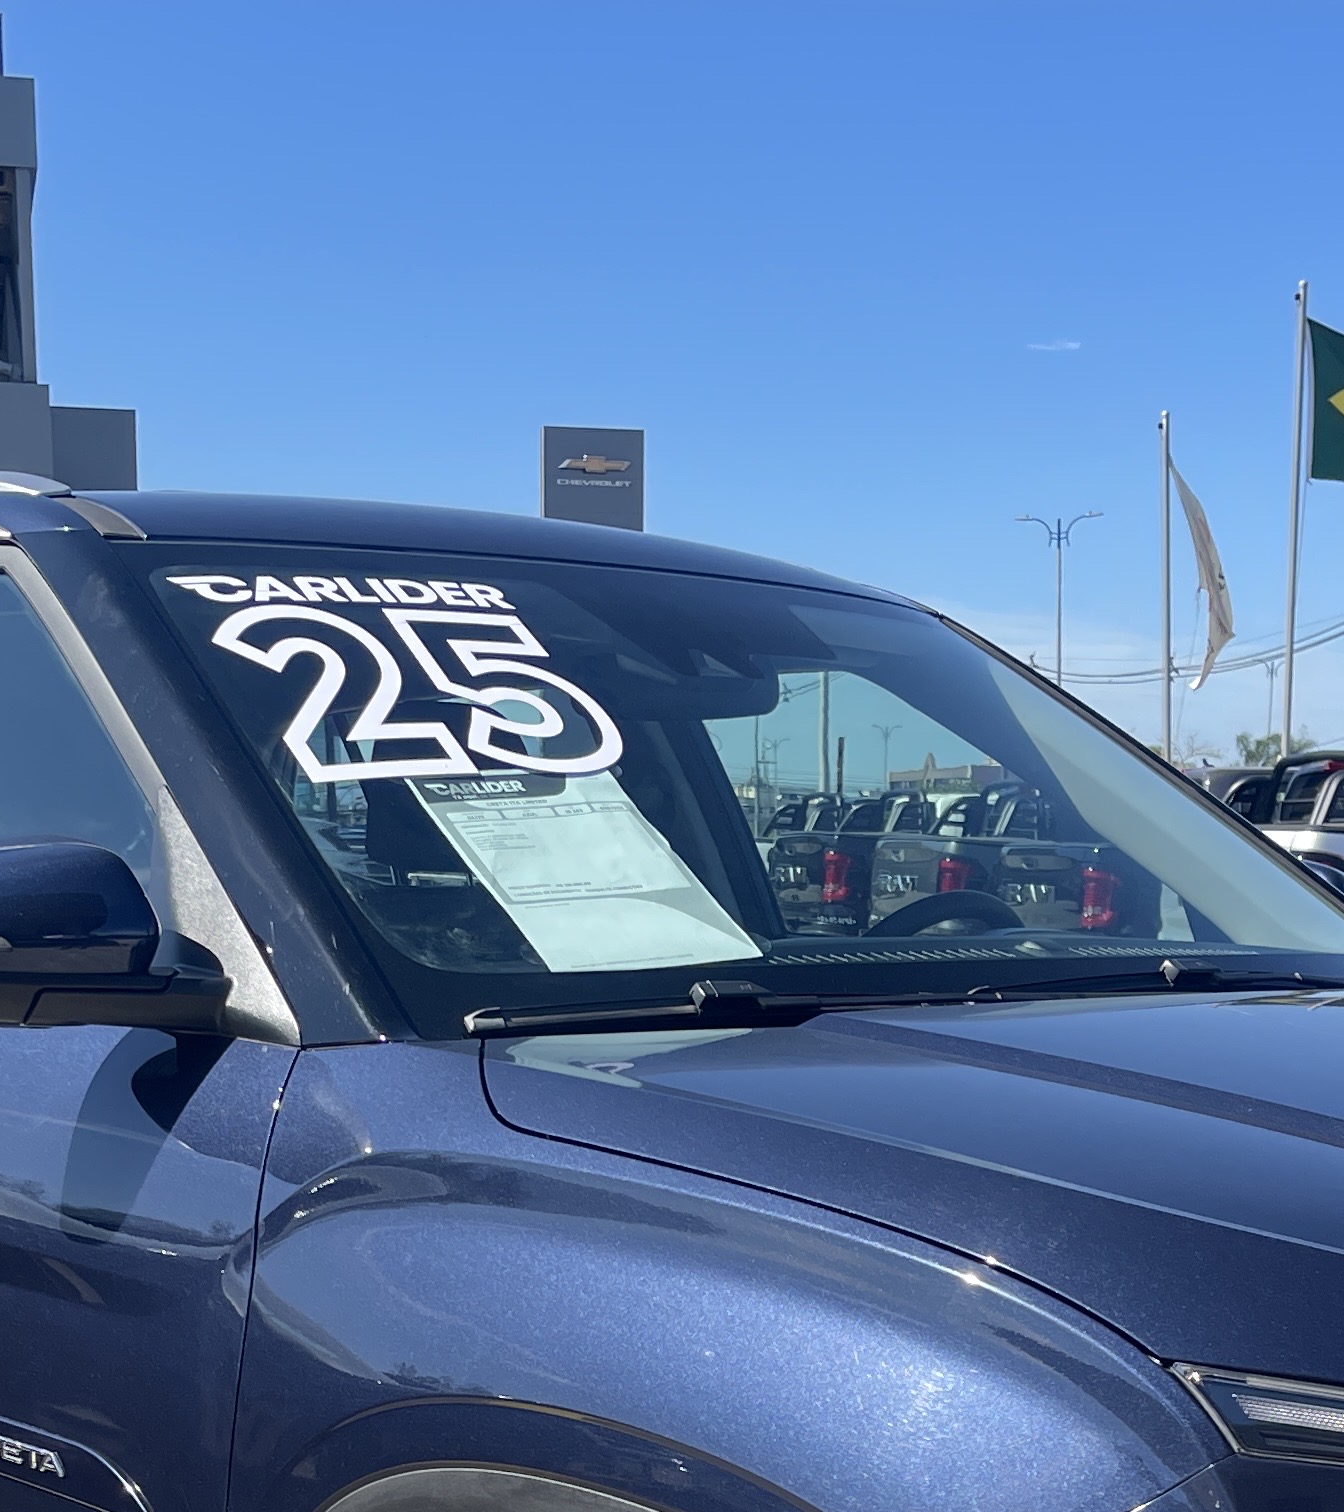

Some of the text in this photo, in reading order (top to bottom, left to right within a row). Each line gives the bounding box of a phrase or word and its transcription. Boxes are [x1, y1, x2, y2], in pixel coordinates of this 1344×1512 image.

[556, 478, 632, 488] CHEVROLET
[165, 574, 517, 610] CARLIDER
[211, 604, 624, 783] 25
[423, 779, 527, 797] CARLIDER
